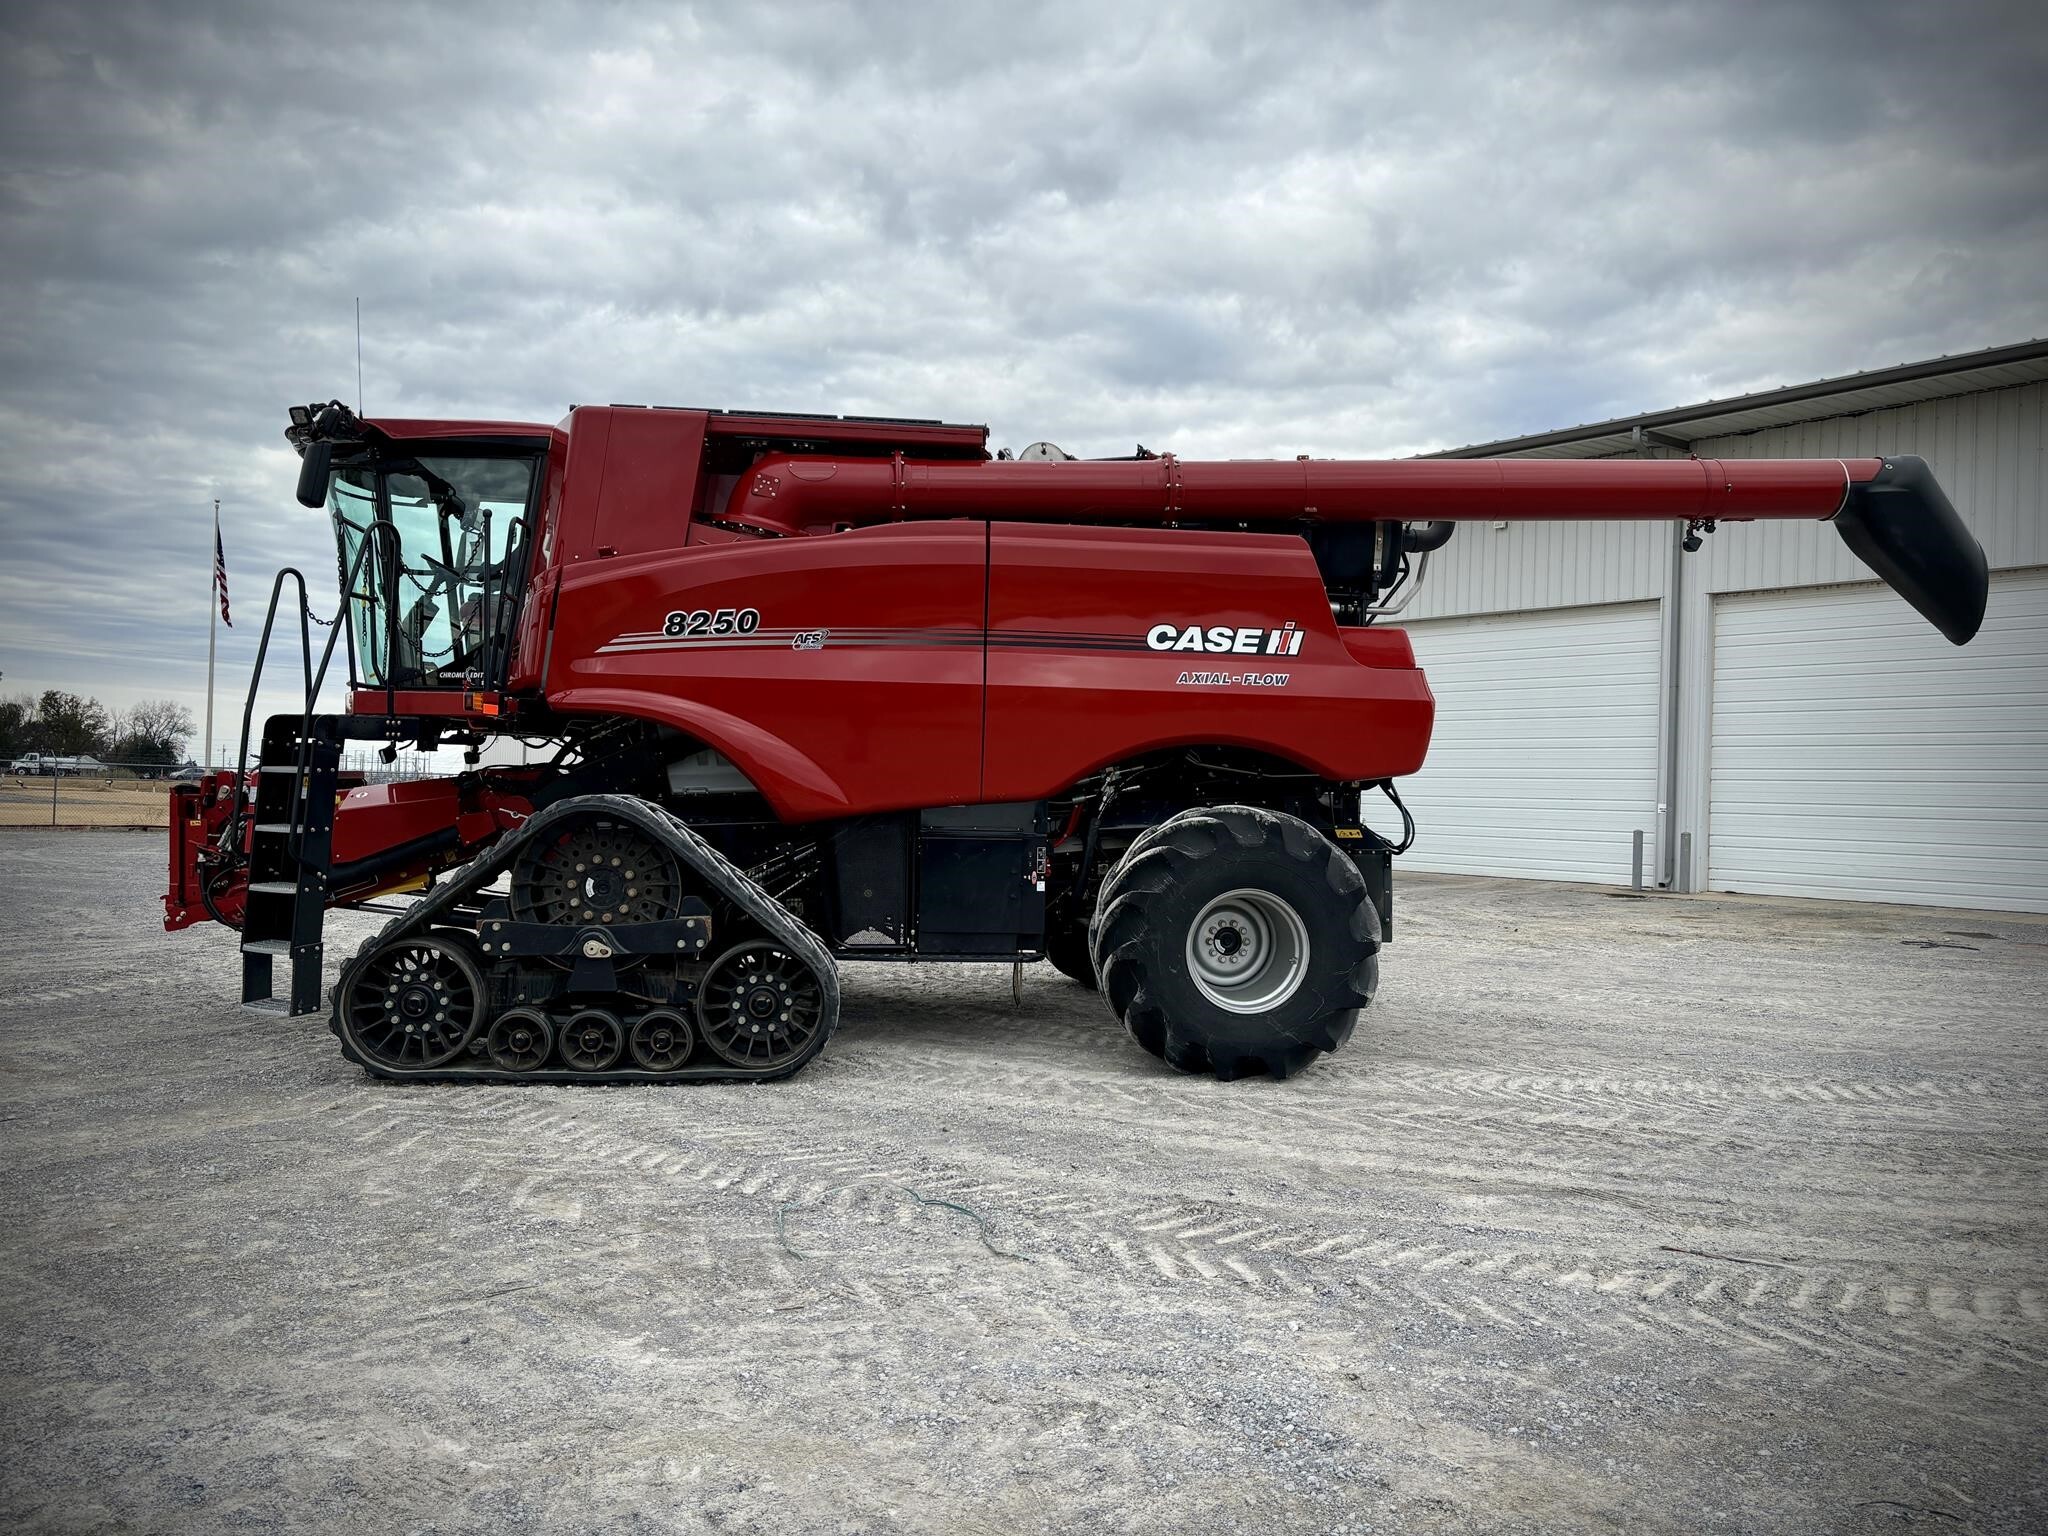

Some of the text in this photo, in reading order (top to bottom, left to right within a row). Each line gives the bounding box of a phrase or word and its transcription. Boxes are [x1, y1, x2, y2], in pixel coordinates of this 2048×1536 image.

[662, 608, 760, 637] 8250
[792, 632, 823, 645] AFS
[1146, 624, 1264, 654] CASE
[439, 671, 465, 679] CHROME
[1176, 671, 1290, 687] AXIAL-FLOW
